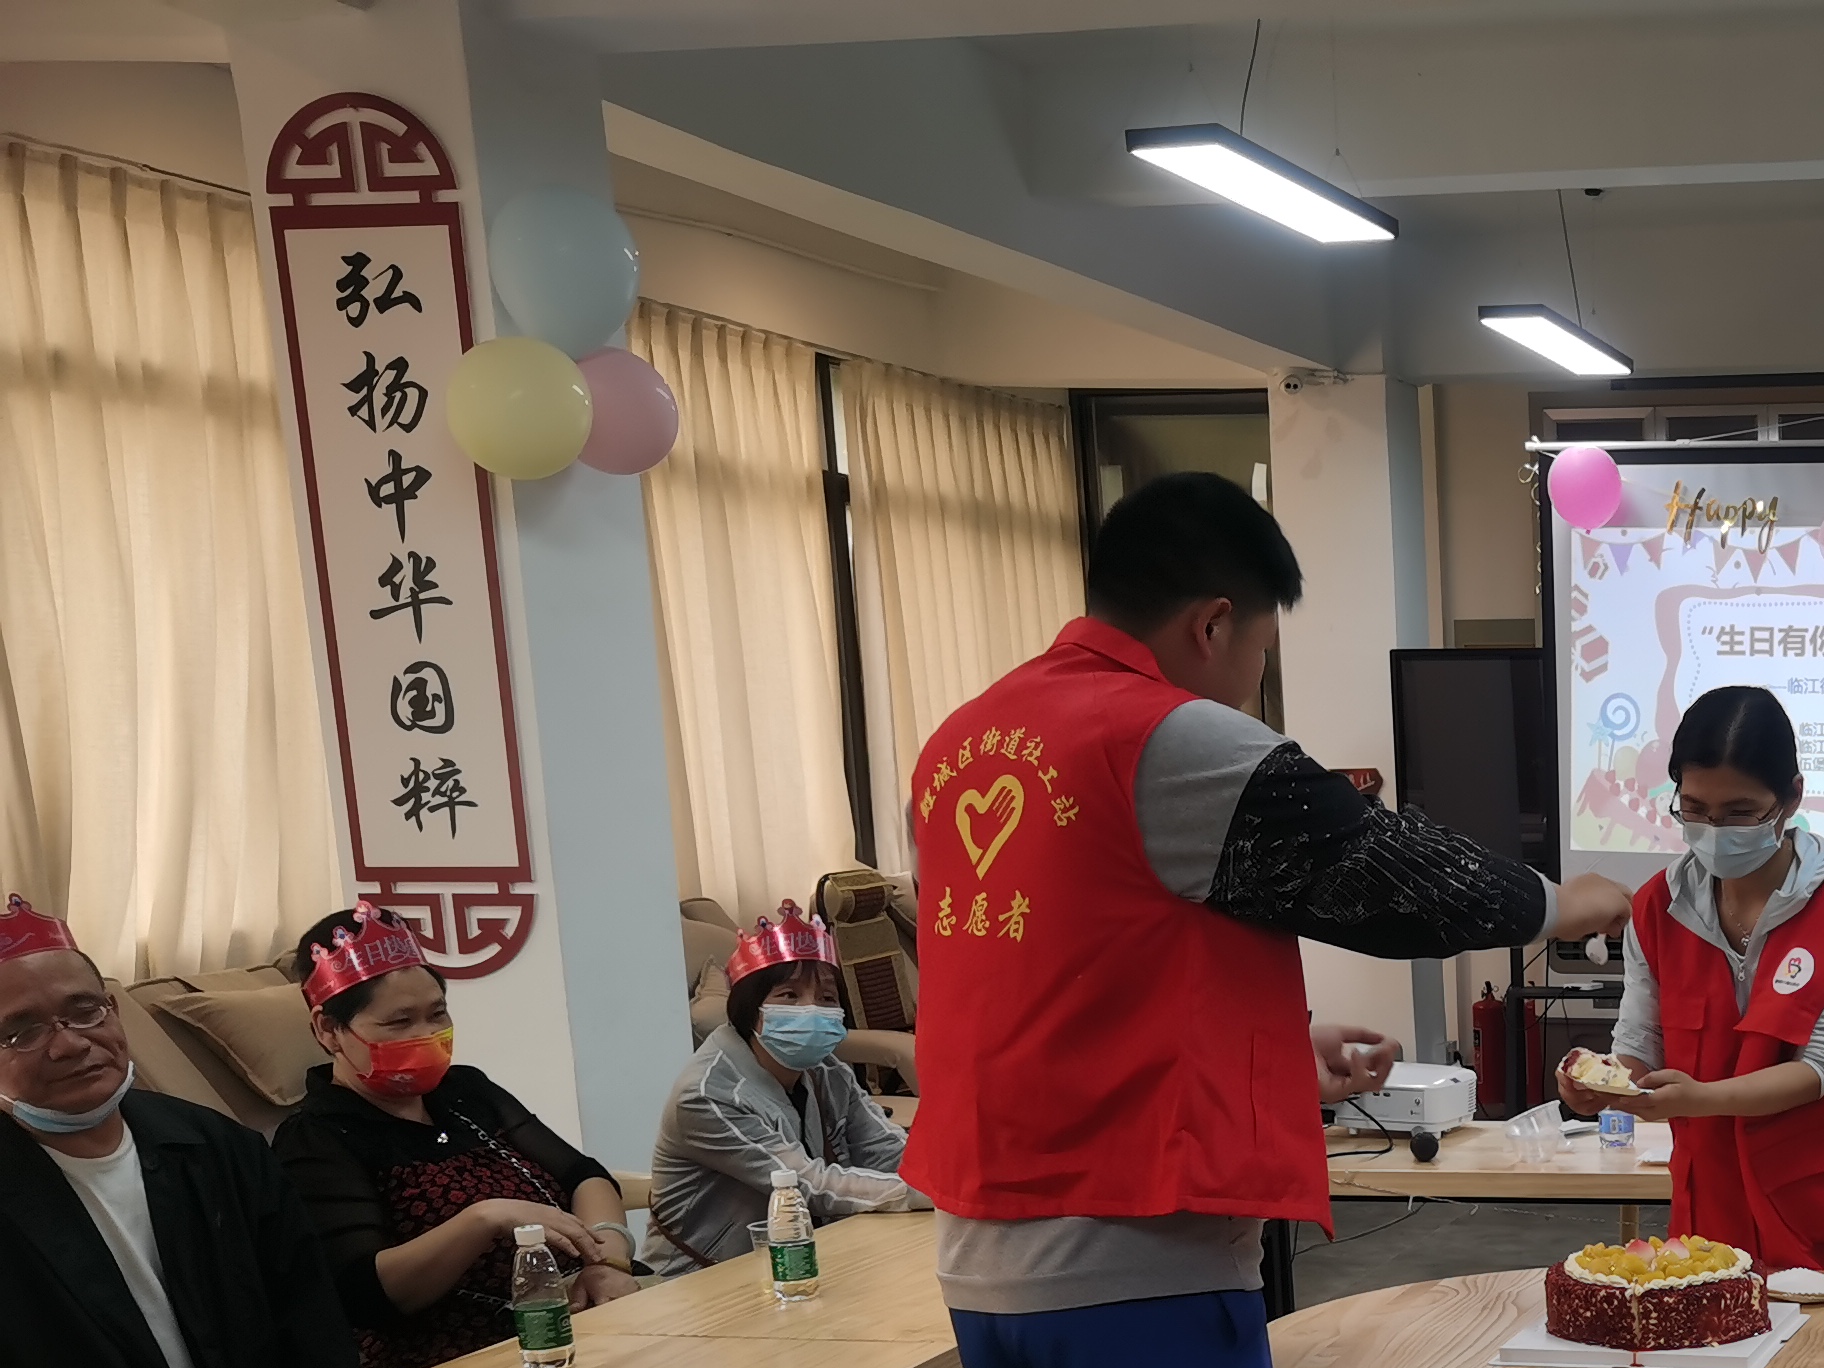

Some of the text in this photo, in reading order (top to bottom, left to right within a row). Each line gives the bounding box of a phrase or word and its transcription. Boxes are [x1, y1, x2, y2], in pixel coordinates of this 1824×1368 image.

[334, 250, 480, 840] 弘扬中华国粹
[1664, 479, 1780, 555] Happy
[934, 886, 1031, 943] 志愿者
